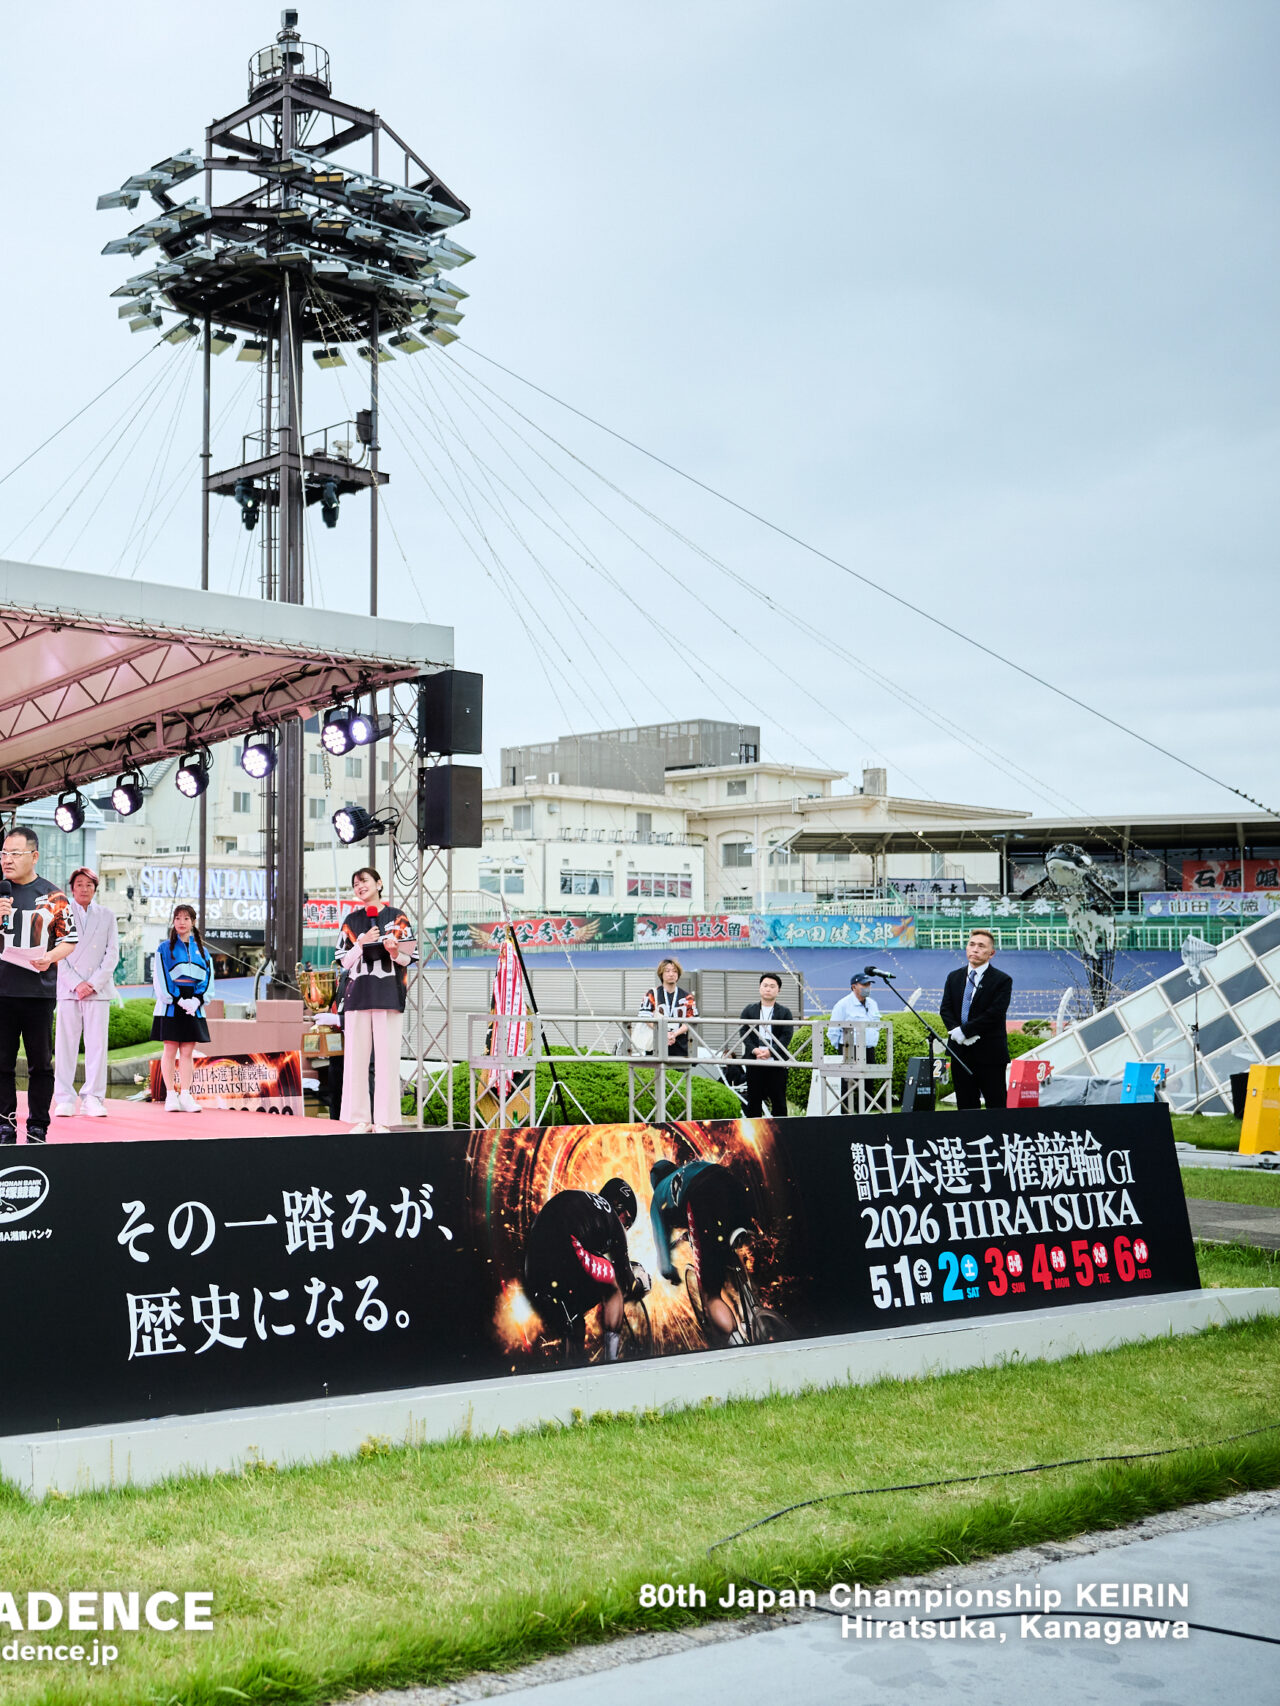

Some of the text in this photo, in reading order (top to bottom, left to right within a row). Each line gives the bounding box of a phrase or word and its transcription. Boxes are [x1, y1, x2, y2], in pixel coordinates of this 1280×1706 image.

[232, 901, 272, 920] Gat
[785, 923, 894, 946] 和田健太郎
[933, 1060, 942, 1077] 2
[1036, 1063, 1046, 1081] 3
[1151, 1065, 1162, 1084] 4
[207, 1082, 261, 1095] HIRATSUKA
[866, 1130, 1106, 1199] 日本選手権競輪
[1106, 1150, 1135, 1184] GI
[117, 1183, 453, 1263] その一踏みが、
[860, 1189, 1142, 1249] 2026 HIRATSUKA
[869, 1255, 915, 1309] 5.1
[938, 1252, 964, 1302] 2
[984, 1247, 1008, 1296] 3
[1032, 1243, 1053, 1290] 4
[1071, 1240, 1094, 1287] 5
[1114, 1236, 1135, 1282] 6
[920, 1268, 1152, 1304] FRI SAT SUN MON TUE WED
[126, 1275, 410, 1360] 歴史になる。
